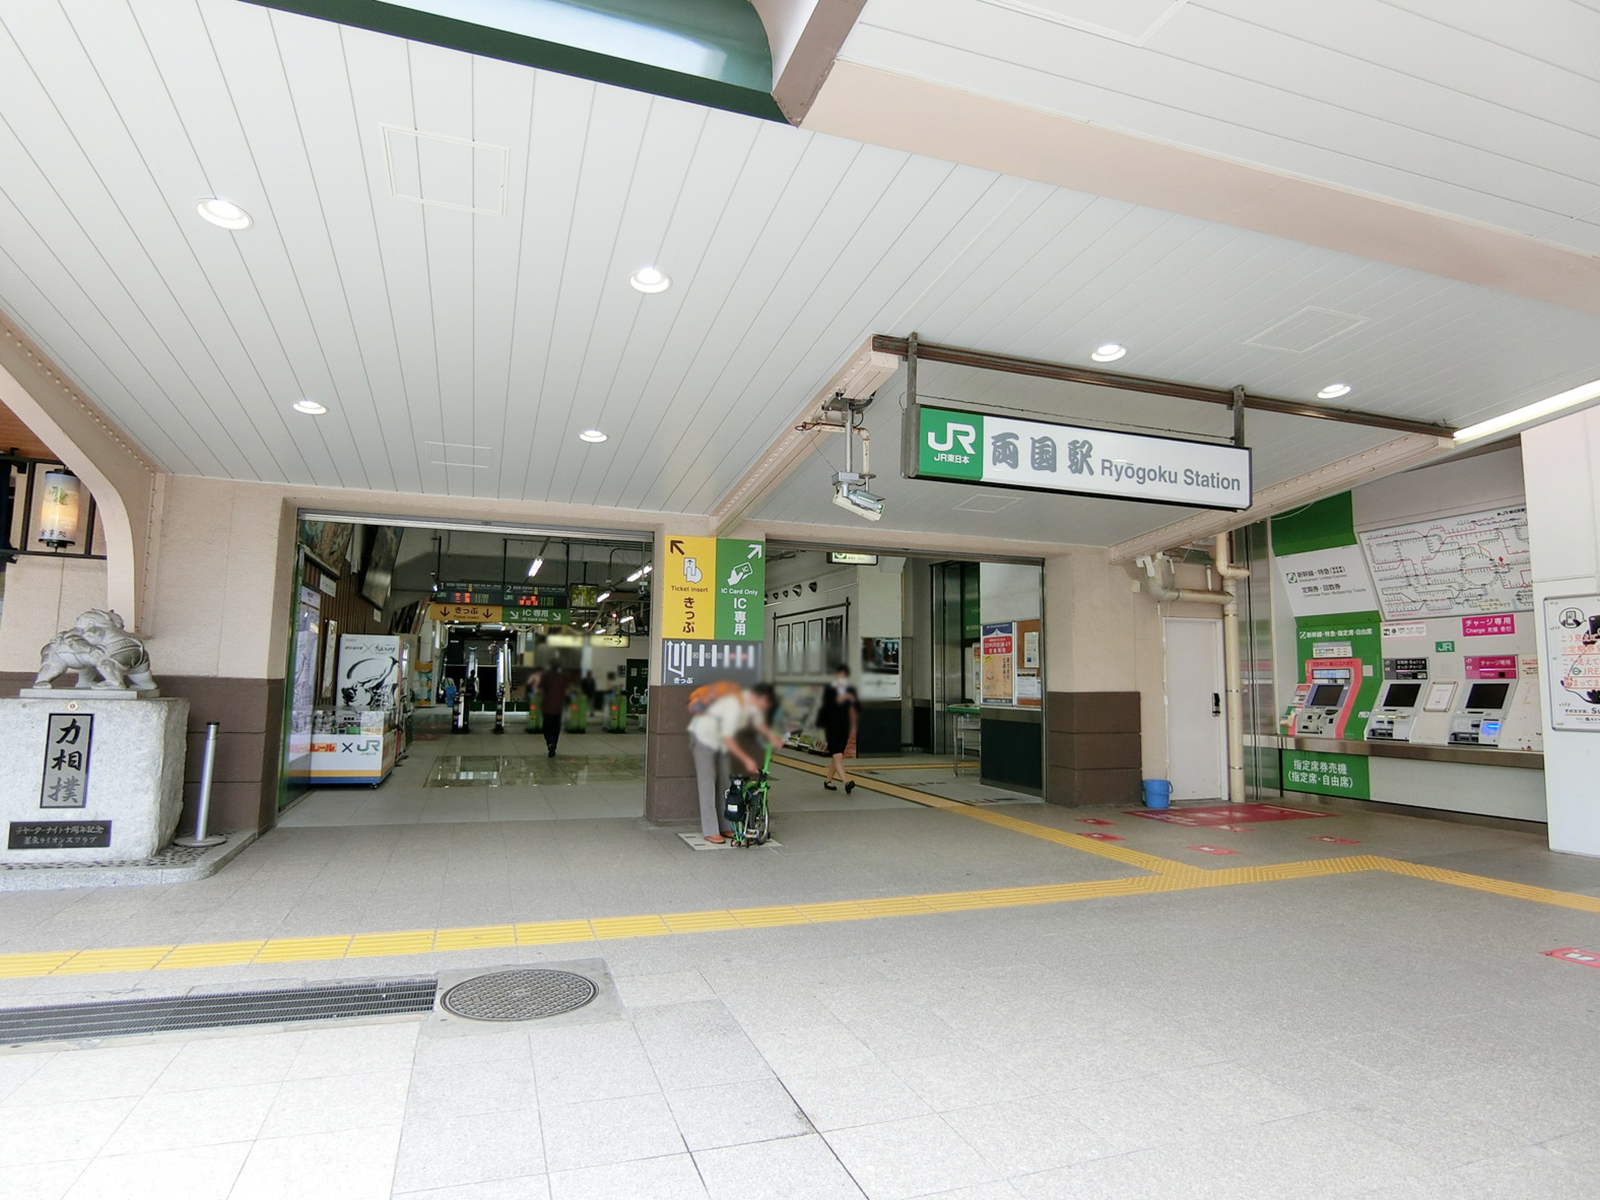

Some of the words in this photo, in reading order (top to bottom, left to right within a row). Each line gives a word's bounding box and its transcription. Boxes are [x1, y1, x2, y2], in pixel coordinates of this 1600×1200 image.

[927, 422, 976, 455] JR
[933, 453, 970, 465] JR東日本
[1100, 458, 1178, 486] Ryōgoku
[1183, 467, 1241, 491] Station
[506, 585, 512, 593] 2
[744, 589, 758, 597] Only
[455, 607, 478, 615] きっぷ
[522, 609, 532, 617] IC
[533, 609, 549, 618] 専用
[683, 597, 695, 634] きっぷ
[1465, 616, 1511, 627] チャージ専用
[1438, 642, 1453, 651] JR
[357, 740, 380, 751] JR
[48, 718, 82, 804] 力相撲
[1293, 759, 1347, 775] 指定席券売機
[1288, 771, 1353, 788] (指定席・自由席)
